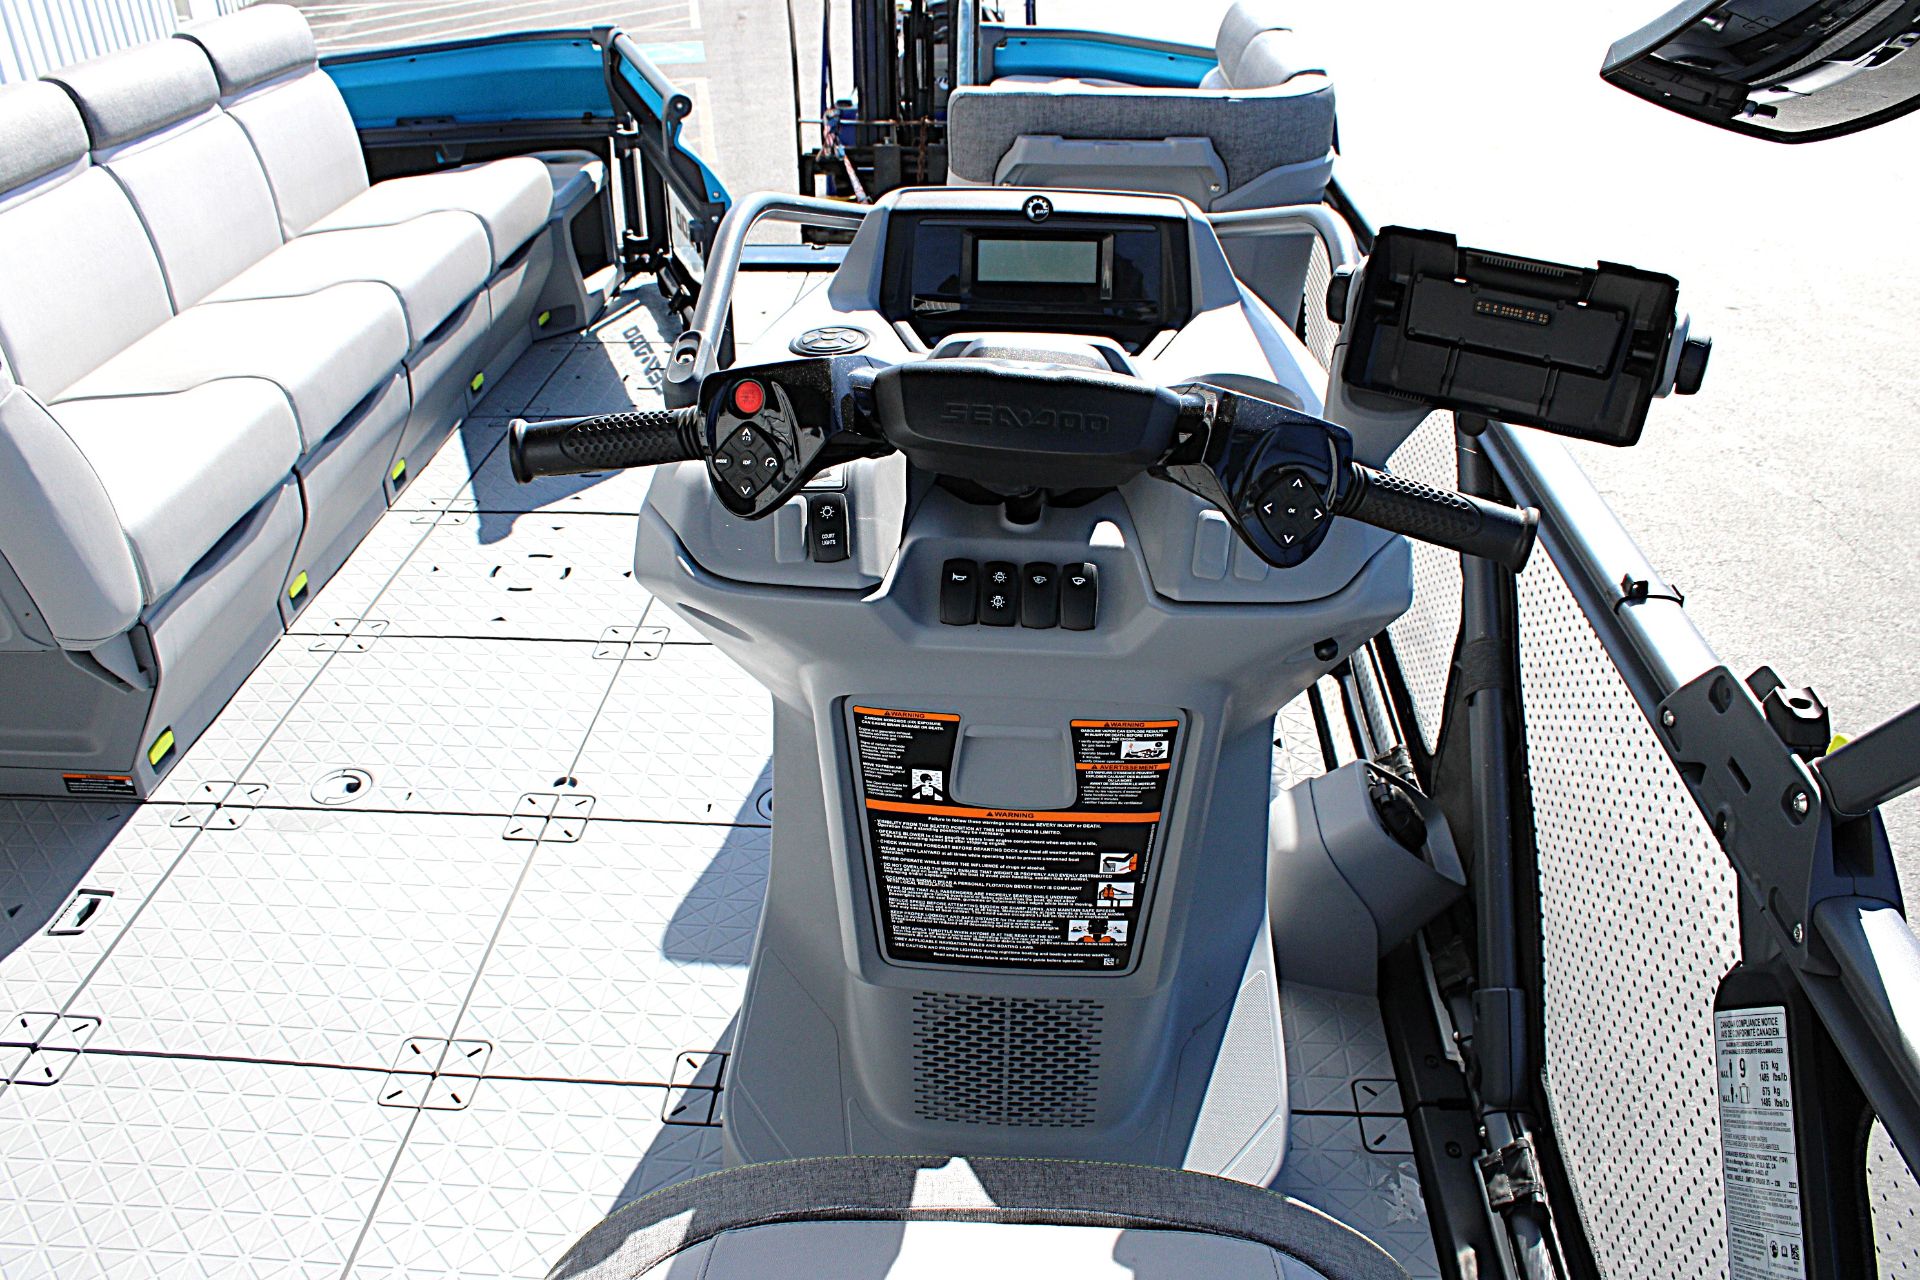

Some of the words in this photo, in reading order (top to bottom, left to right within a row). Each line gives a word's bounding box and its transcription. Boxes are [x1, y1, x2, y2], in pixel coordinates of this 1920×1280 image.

[891, 710, 926, 719] WARNING
[1737, 1019, 1760, 1027] COMPLIANCE
[1761, 1017, 1778, 1026] NOTICE
[1757, 1028, 1779, 1036] CANADIEN
[1740, 1058, 1746, 1078] 9
[1772, 1061, 1778, 1071] kg
[1774, 1086, 1780, 1096] kg
